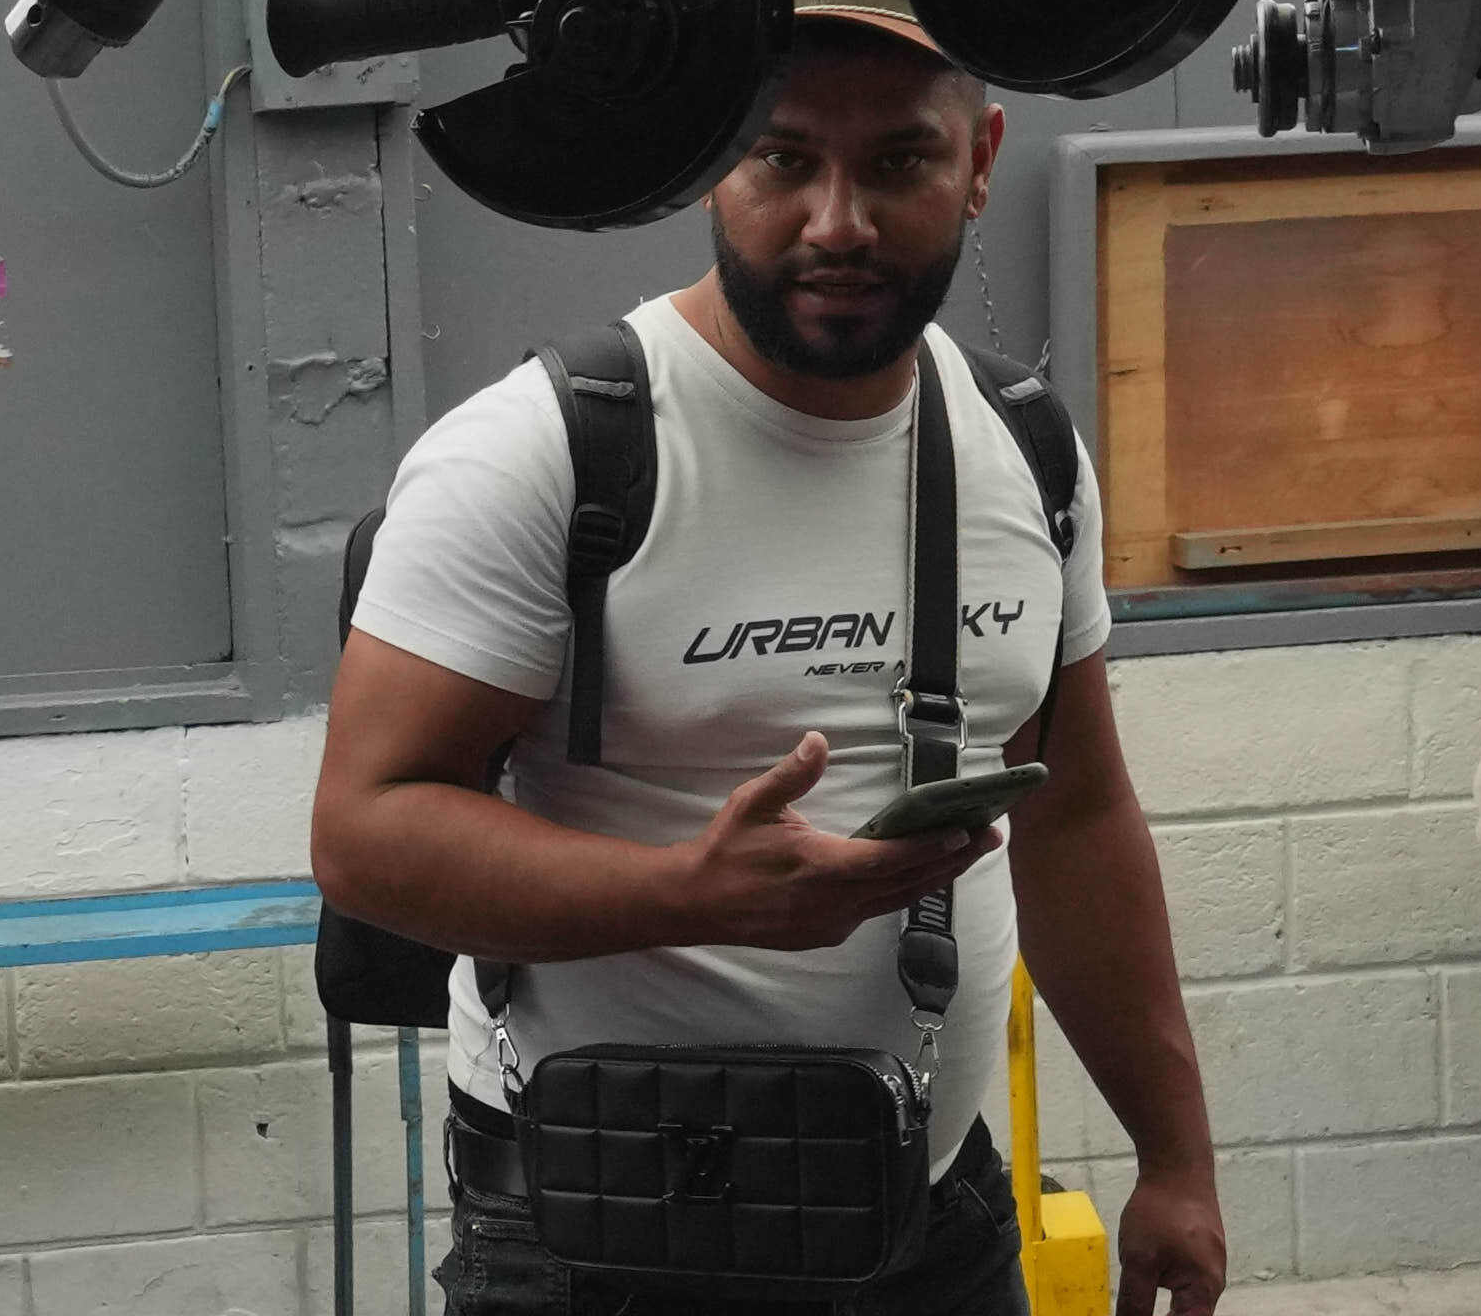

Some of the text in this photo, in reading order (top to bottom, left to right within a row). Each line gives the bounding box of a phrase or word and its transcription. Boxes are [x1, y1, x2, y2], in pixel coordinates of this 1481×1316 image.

[683, 599, 1024, 665] URBAN KY
[803, 660, 885, 677] NEVER
